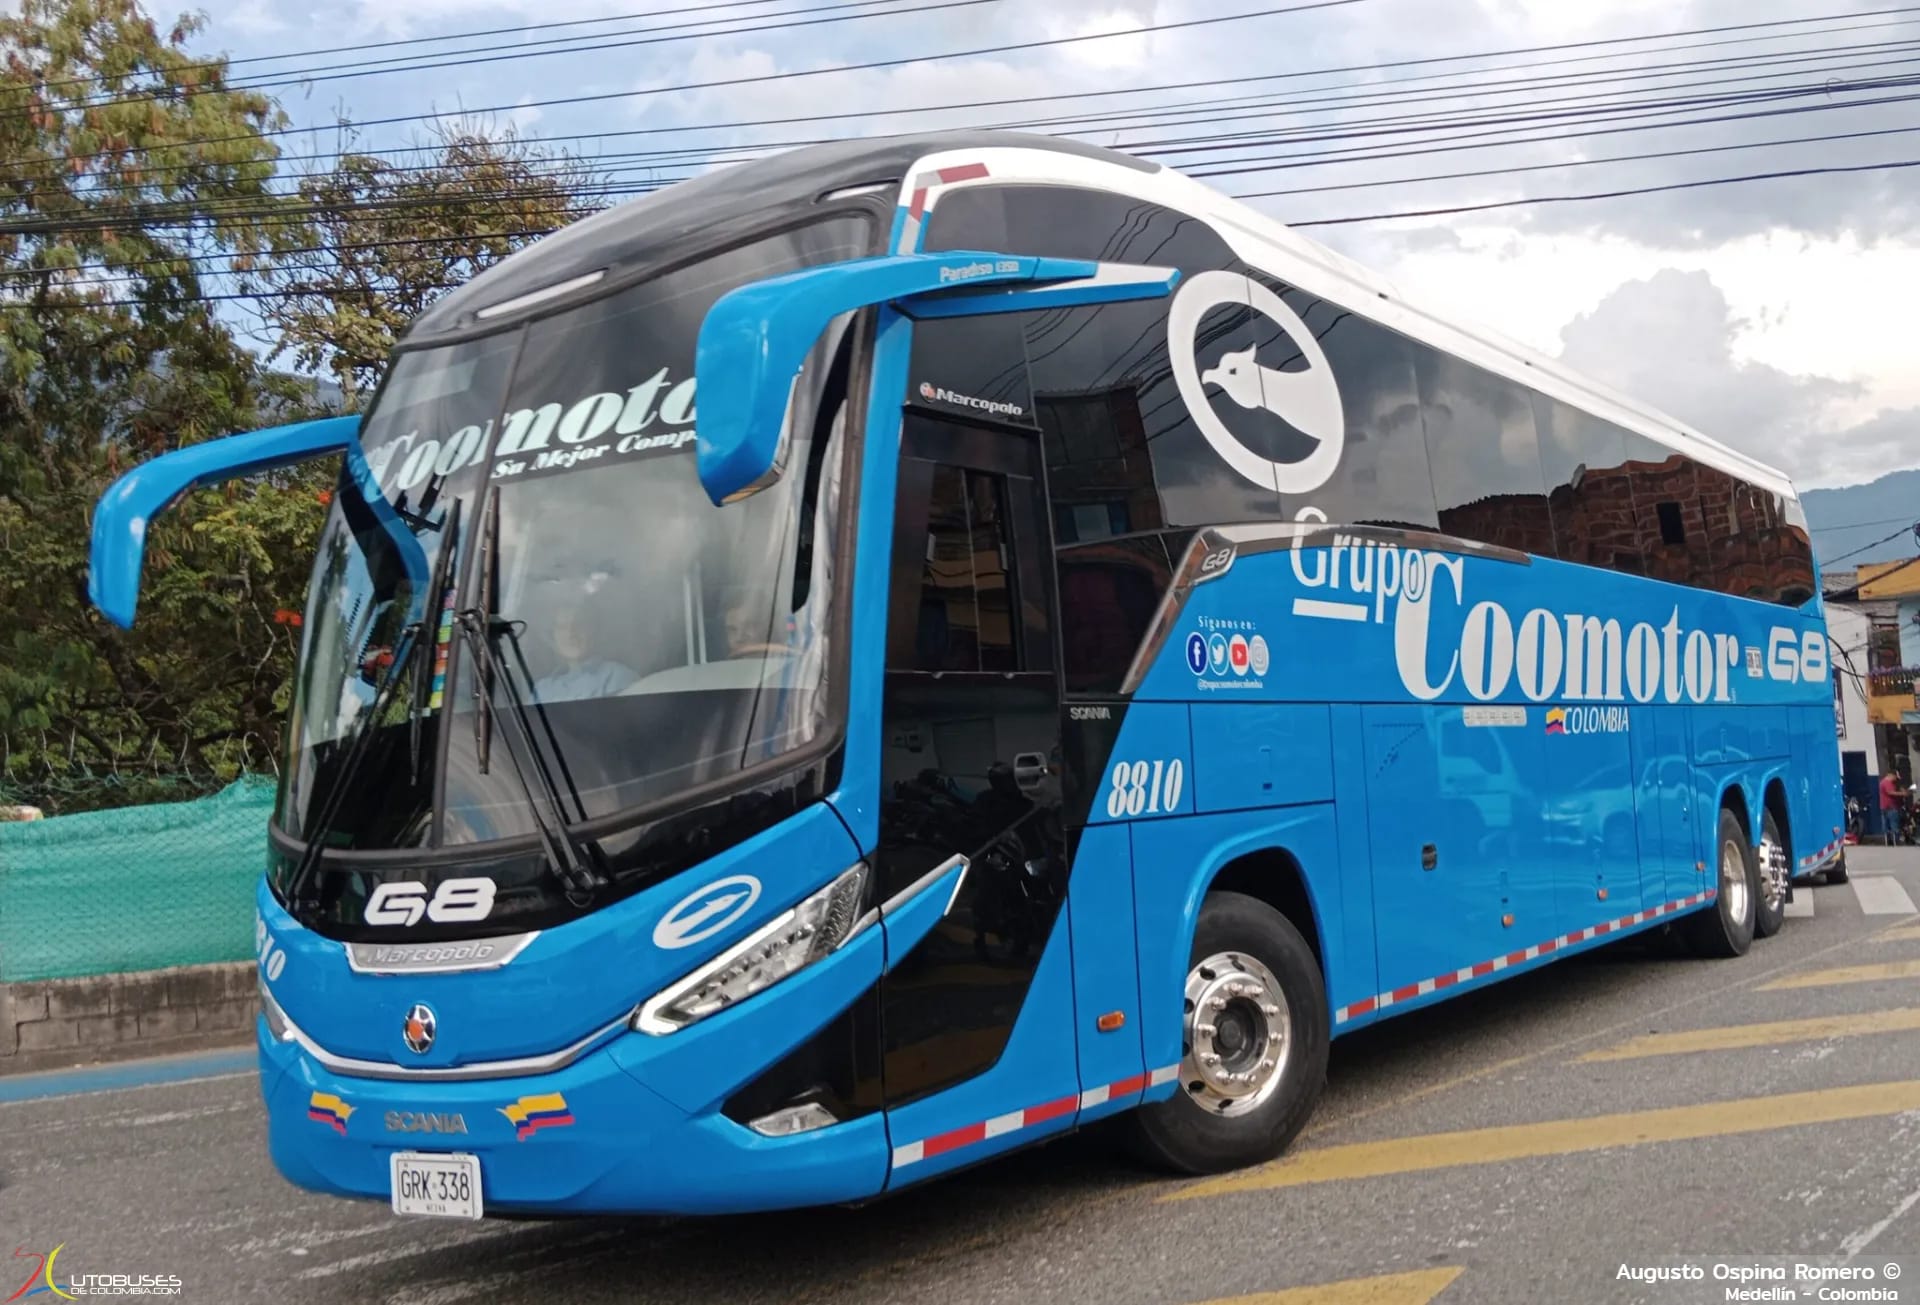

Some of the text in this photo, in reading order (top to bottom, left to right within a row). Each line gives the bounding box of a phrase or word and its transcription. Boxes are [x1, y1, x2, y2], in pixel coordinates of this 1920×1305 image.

[936, 388, 1022, 415] Marcopolo
[364, 367, 697, 503] Coomoto
[490, 429, 697, 479] Su Mejor Comp
[1202, 548, 1230, 571] G8
[1290, 506, 1426, 623] Grupo
[1394, 552, 1739, 703] Coomotor
[1767, 625, 1827, 684] G8
[1070, 707, 1111, 720] SCANIA
[1563, 707, 1629, 734] COLOMBIA
[1107, 758, 1183, 817] 8810
[364, 877, 497, 927] G8
[368, 943, 493, 964] Marcopolo
[385, 1111, 468, 1134] SCANIA
